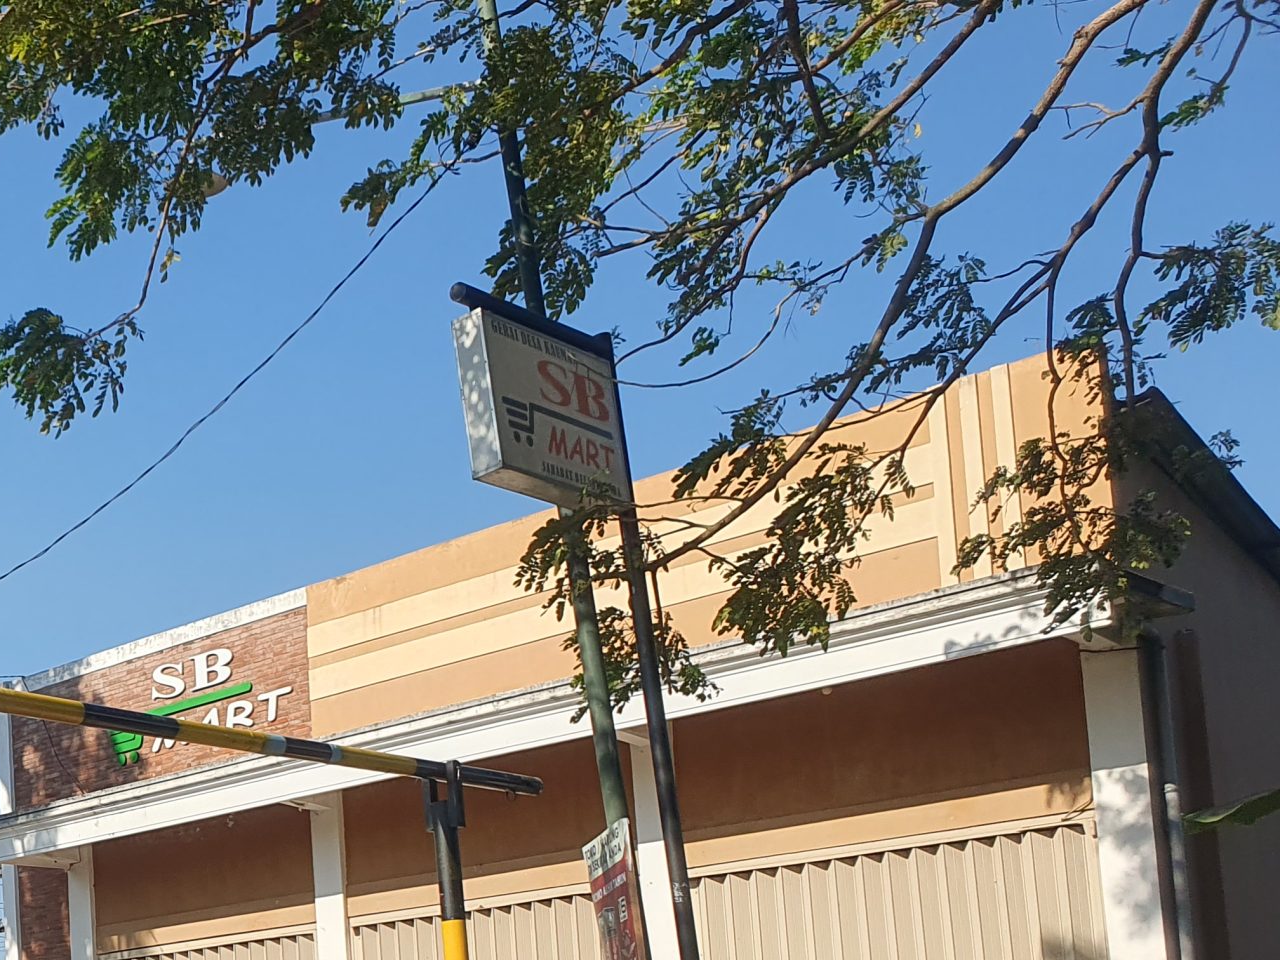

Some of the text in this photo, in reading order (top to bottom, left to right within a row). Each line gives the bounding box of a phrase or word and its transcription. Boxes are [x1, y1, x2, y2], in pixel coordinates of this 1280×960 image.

[537, 360, 610, 422] SB
[548, 425, 615, 469] MART
[151, 648, 234, 701] SB
